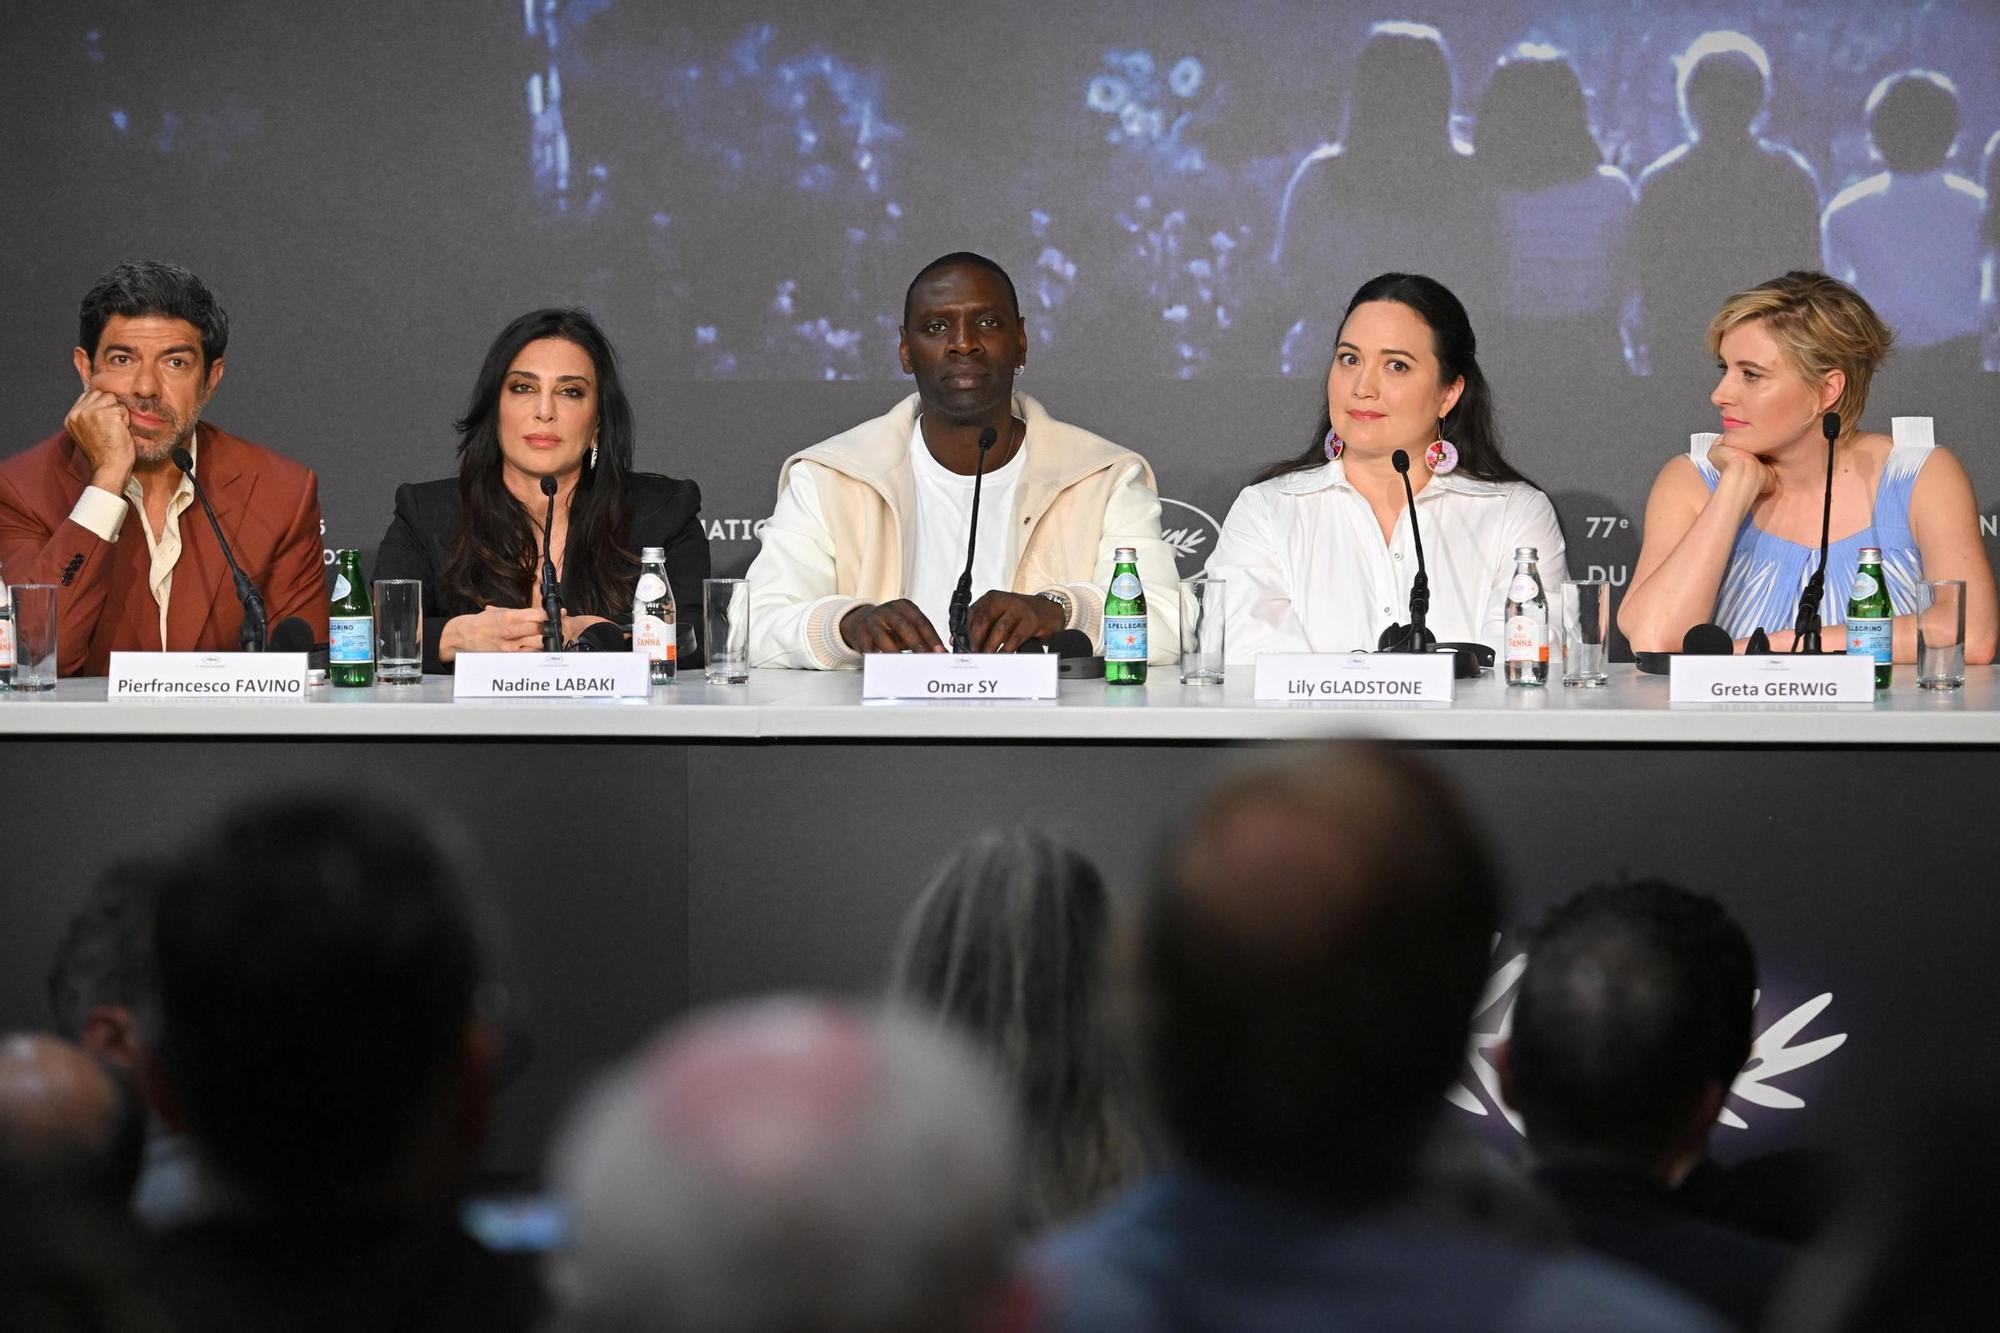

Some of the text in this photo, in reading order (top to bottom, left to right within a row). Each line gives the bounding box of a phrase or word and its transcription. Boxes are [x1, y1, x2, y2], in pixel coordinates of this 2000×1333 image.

[1586, 516, 1629, 539] 77e
[1588, 564, 1627, 587] DU
[118, 678, 301, 693] Pierfrancesco FAVINO
[492, 678, 615, 692] Nadine LABAKI
[927, 680, 998, 693] Omar SY
[1288, 680, 1423, 697] Lily GLADSTONE
[1711, 682, 1838, 696] Greta GERWIG
